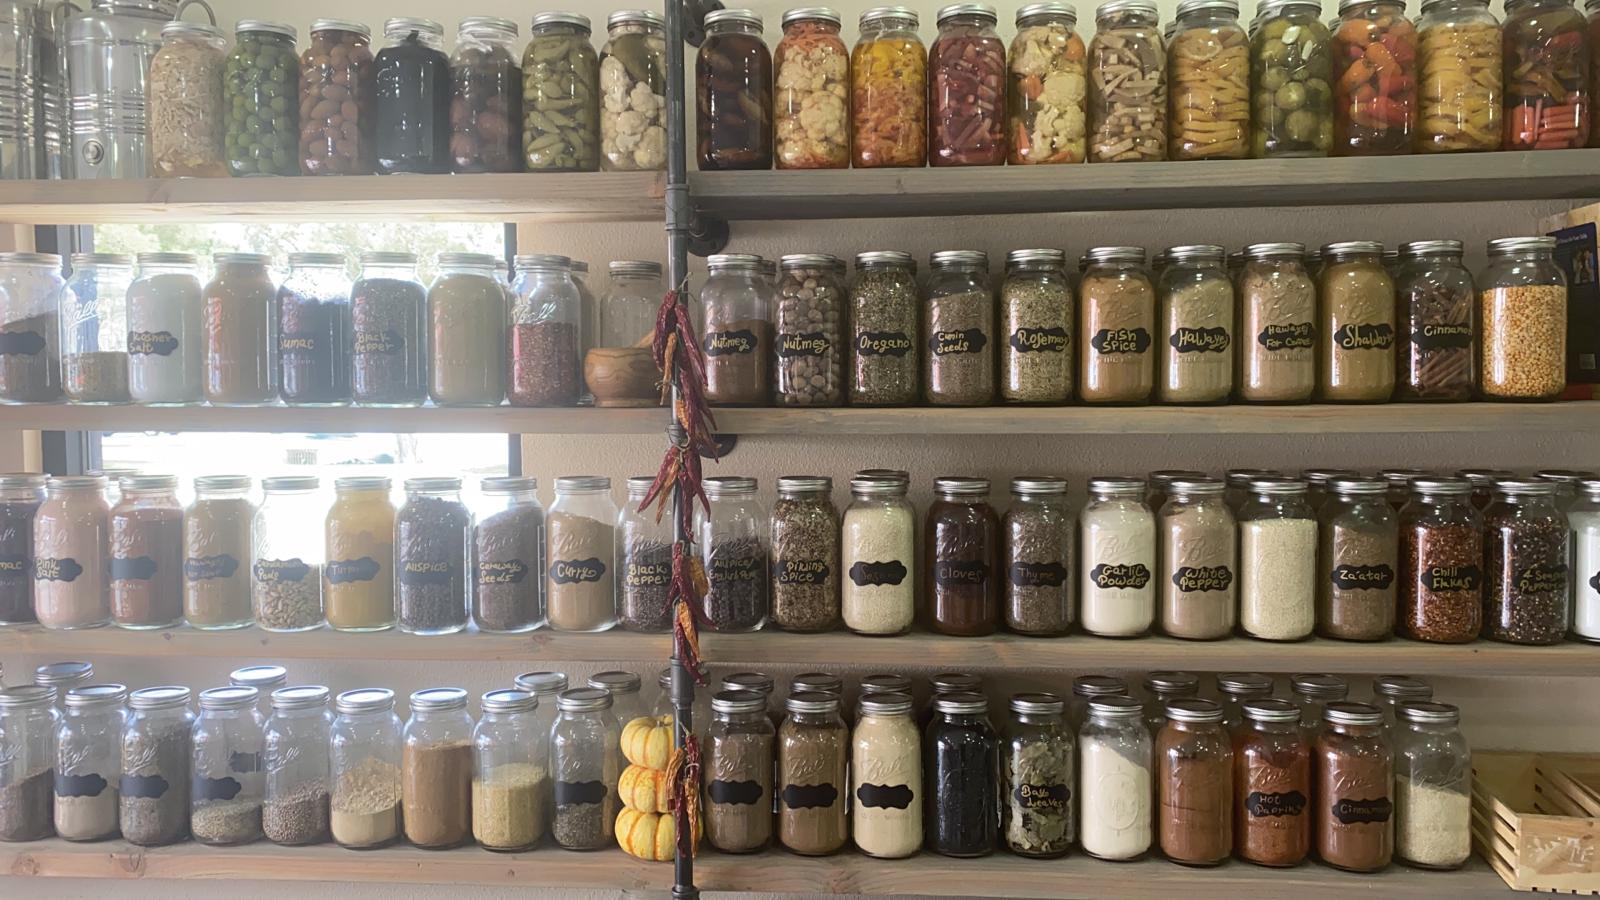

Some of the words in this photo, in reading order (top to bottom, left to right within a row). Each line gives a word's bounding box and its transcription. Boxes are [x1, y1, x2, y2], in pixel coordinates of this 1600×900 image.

[356, 332, 391, 344] Black
[937, 332, 965, 341] Cumin
[354, 343, 394, 354] Pepper
[709, 336, 750, 350] Nutmeg
[783, 338, 830, 354] Nutmeg
[860, 336, 910, 350] Oregano
[937, 340, 969, 354] Seeds
[1266, 339, 1283, 348] For
[0, 561, 23, 570] mac
[36, 558, 57, 570] Pink
[628, 564, 667, 575] Black
[557, 563, 597, 579] Curry
[781, 572, 815, 582] Spice
[939, 567, 983, 582] Cloves
[1017, 567, 1056, 583] Thyme
[1102, 566, 1144, 577] Garlic
[1185, 567, 1227, 579] White
[480, 571, 514, 584] Seeds
[627, 574, 671, 586] Pepper
[1098, 575, 1147, 587] Powder
[1180, 577, 1228, 591] Pepper
